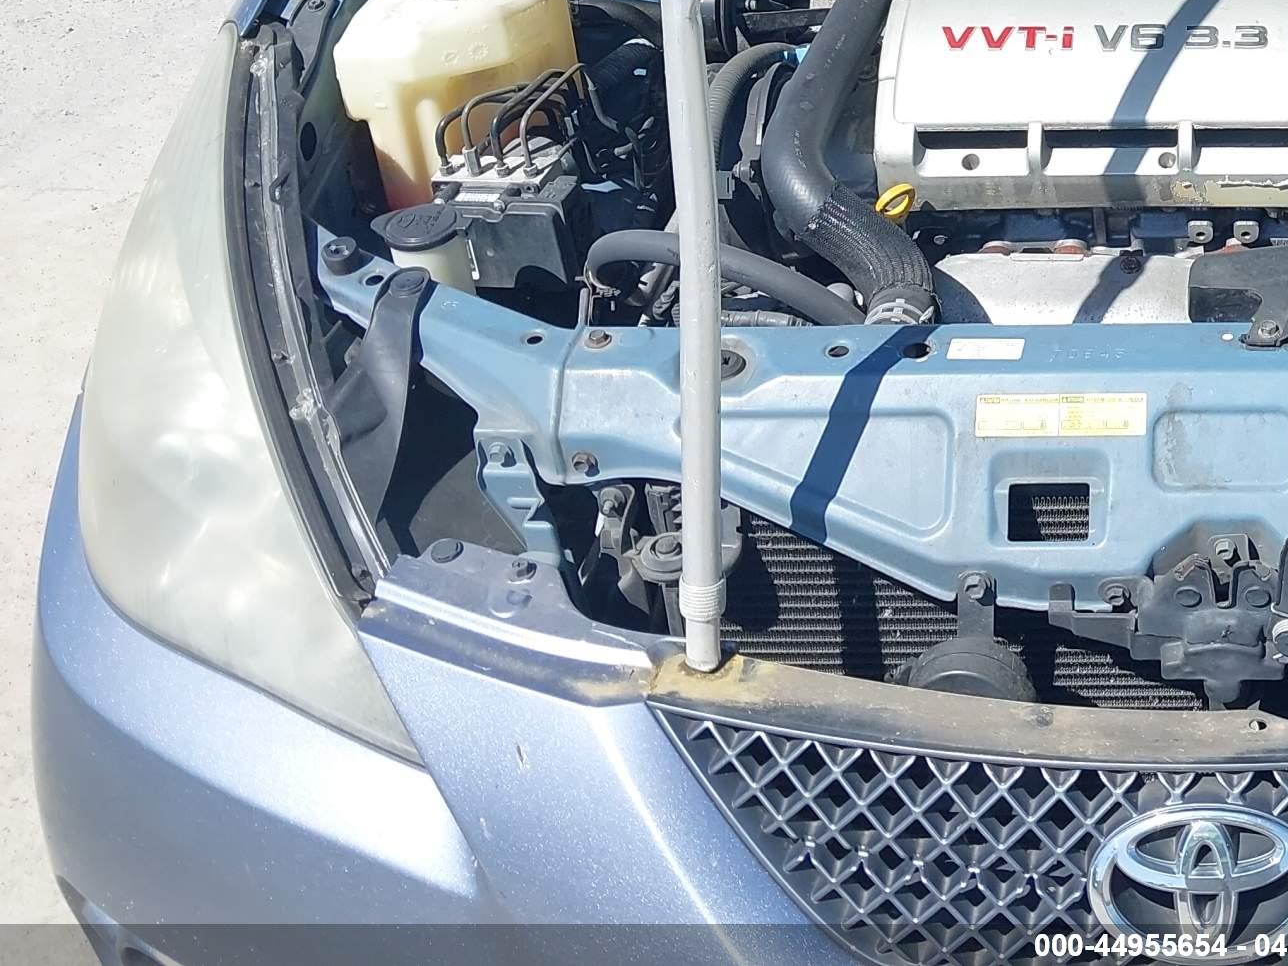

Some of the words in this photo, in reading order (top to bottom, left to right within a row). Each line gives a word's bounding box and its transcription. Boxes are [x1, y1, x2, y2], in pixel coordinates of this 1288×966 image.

[942, 26, 1075, 50] VVT-i
[1094, 24, 1167, 51] V6
[1184, 24, 1268, 50] 3.3
